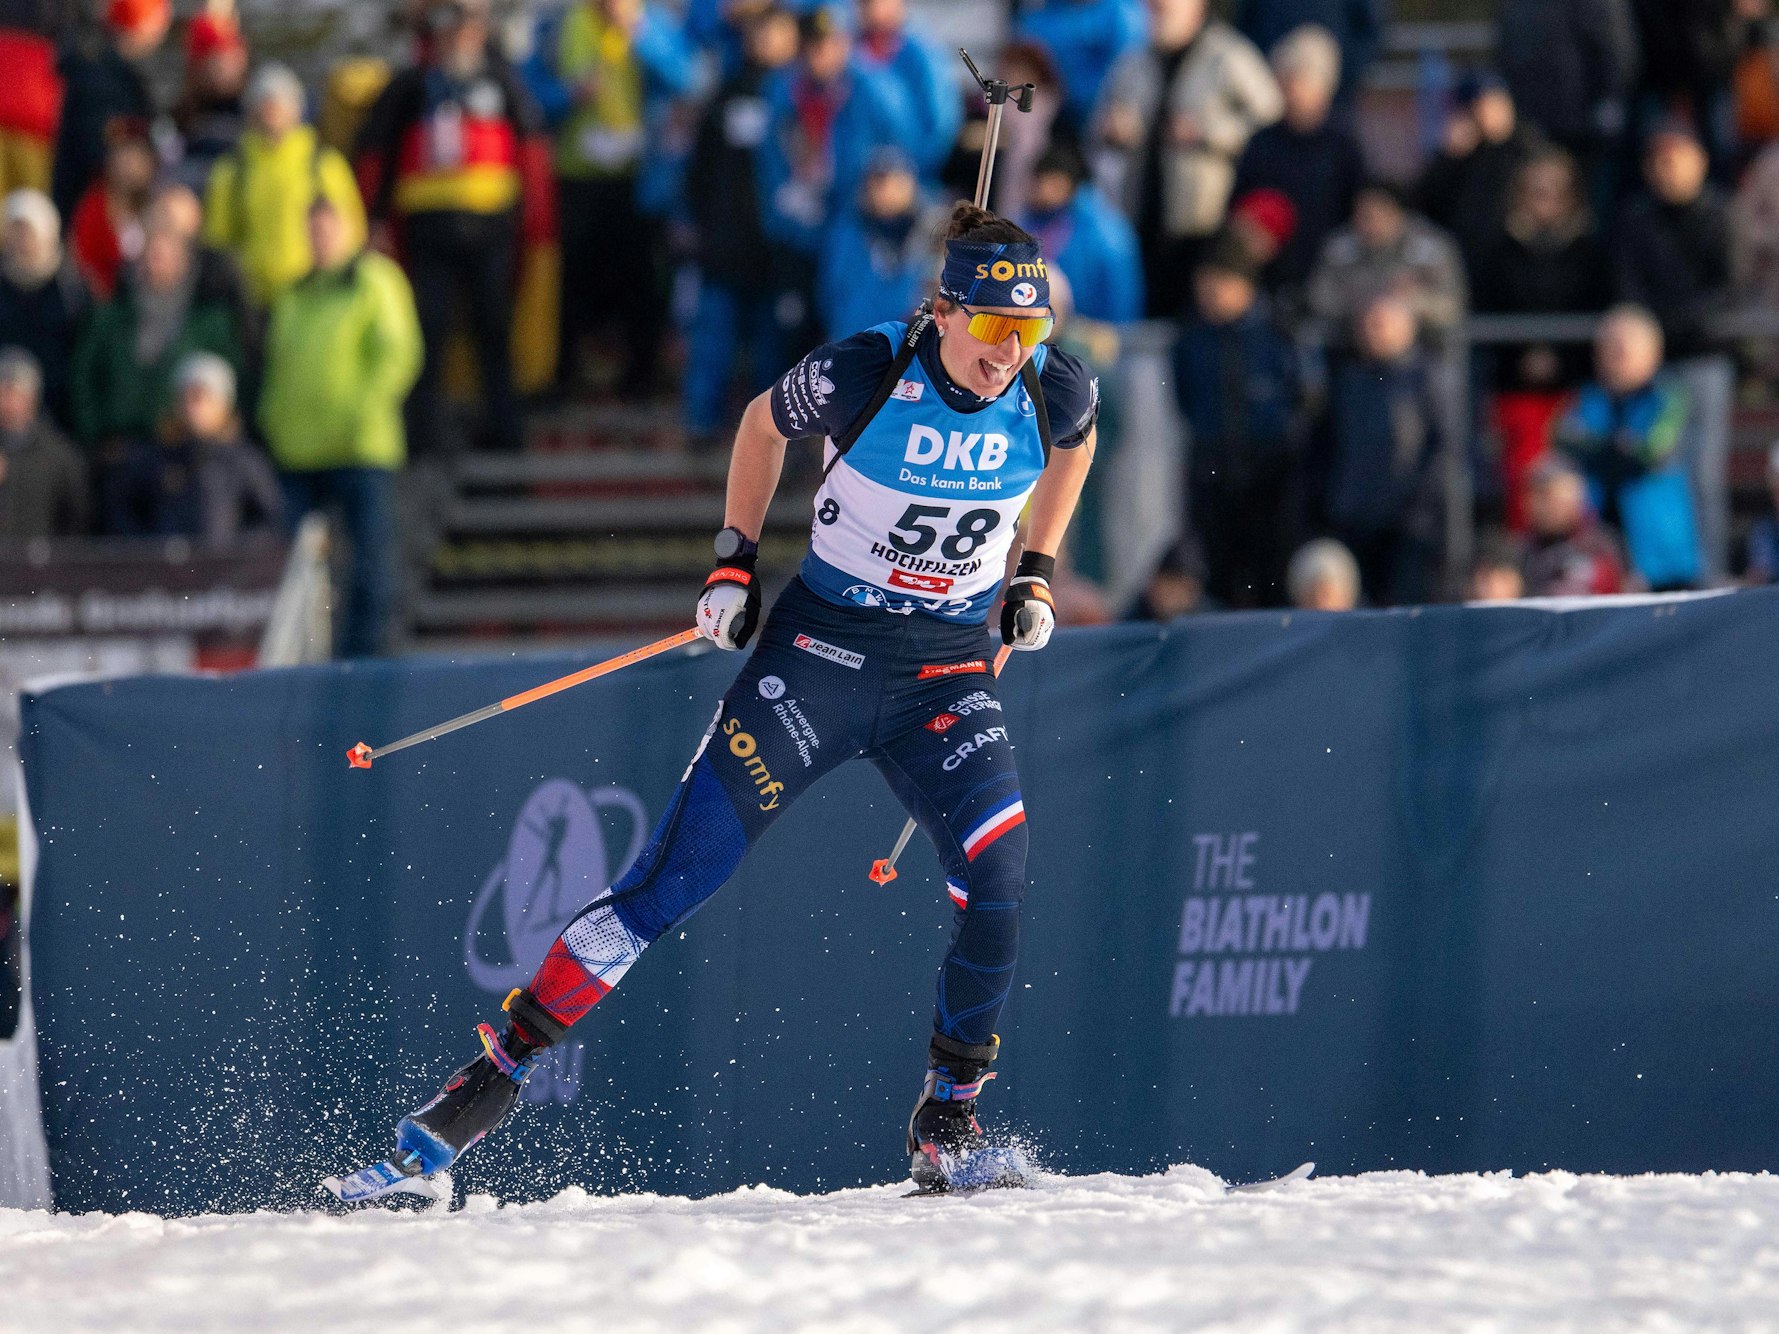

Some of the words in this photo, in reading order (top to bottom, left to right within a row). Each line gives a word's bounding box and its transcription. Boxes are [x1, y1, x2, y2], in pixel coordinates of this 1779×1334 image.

[783, 367, 803, 430] omfy
[903, 423, 1009, 471] DKB
[899, 468, 926, 486] Das
[931, 474, 964, 490] kann
[969, 477, 1002, 490] Bank
[817, 498, 840, 525] 8
[888, 503, 1001, 561] 58
[870, 542, 982, 576] HOCHFILZEN
[851, 587, 883, 602] BMW
[809, 642, 837, 657] Jean
[837, 651, 862, 665] Lain
[784, 698, 819, 750] Auvergne-
[948, 691, 991, 711] CAISSE
[772, 703, 813, 768] Rhône-Alpes
[942, 726, 1008, 771] CRAFT
[723, 718, 785, 811] somfy
[1193, 831, 1259, 889] THE
[1179, 891, 1371, 954] BIATHLON
[1169, 957, 1312, 1017] FAMILY
